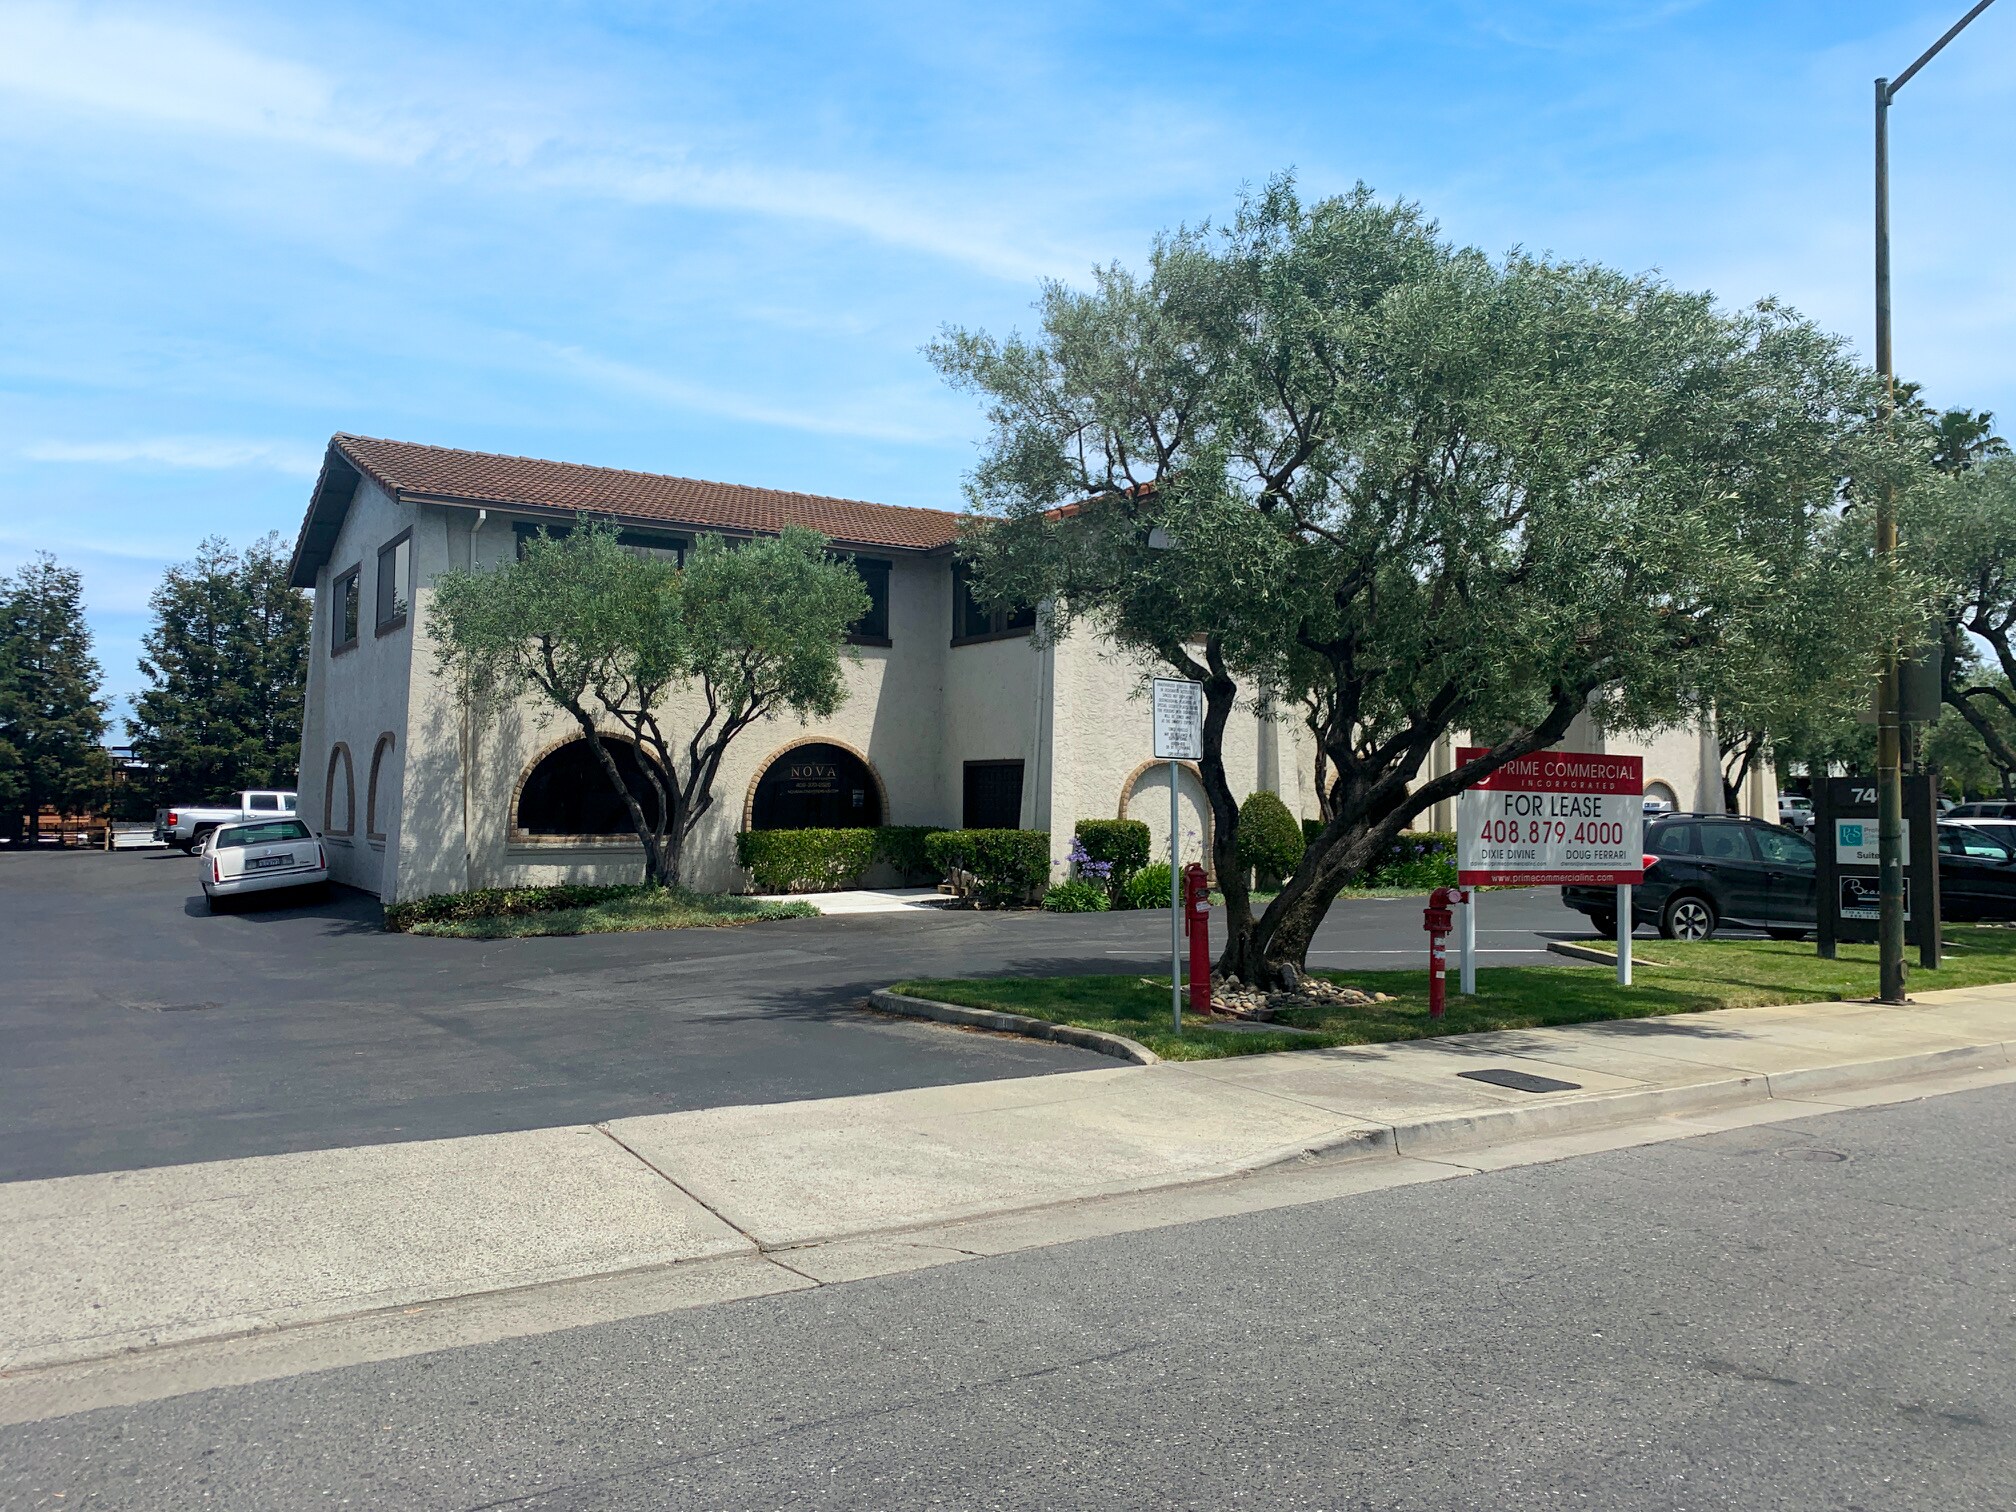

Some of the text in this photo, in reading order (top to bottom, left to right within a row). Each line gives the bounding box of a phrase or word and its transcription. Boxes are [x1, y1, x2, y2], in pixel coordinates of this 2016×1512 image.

[791, 765, 836, 777] NOVA
[1498, 760, 1540, 777] PRIME
[1544, 762, 1636, 780] COMMERCIAL
[1521, 779, 1616, 790] INCORPORATED
[1850, 787, 1880, 804] 74
[1504, 794, 1602, 818] FOR LEASE
[1480, 819, 1623, 845] 408.879.4000
[1481, 849, 1536, 860] DIXIE DIVINE
[1566, 850, 1627, 860] DOUG FERRARI
[1491, 873, 1614, 884] www.primecommercialinc.com
